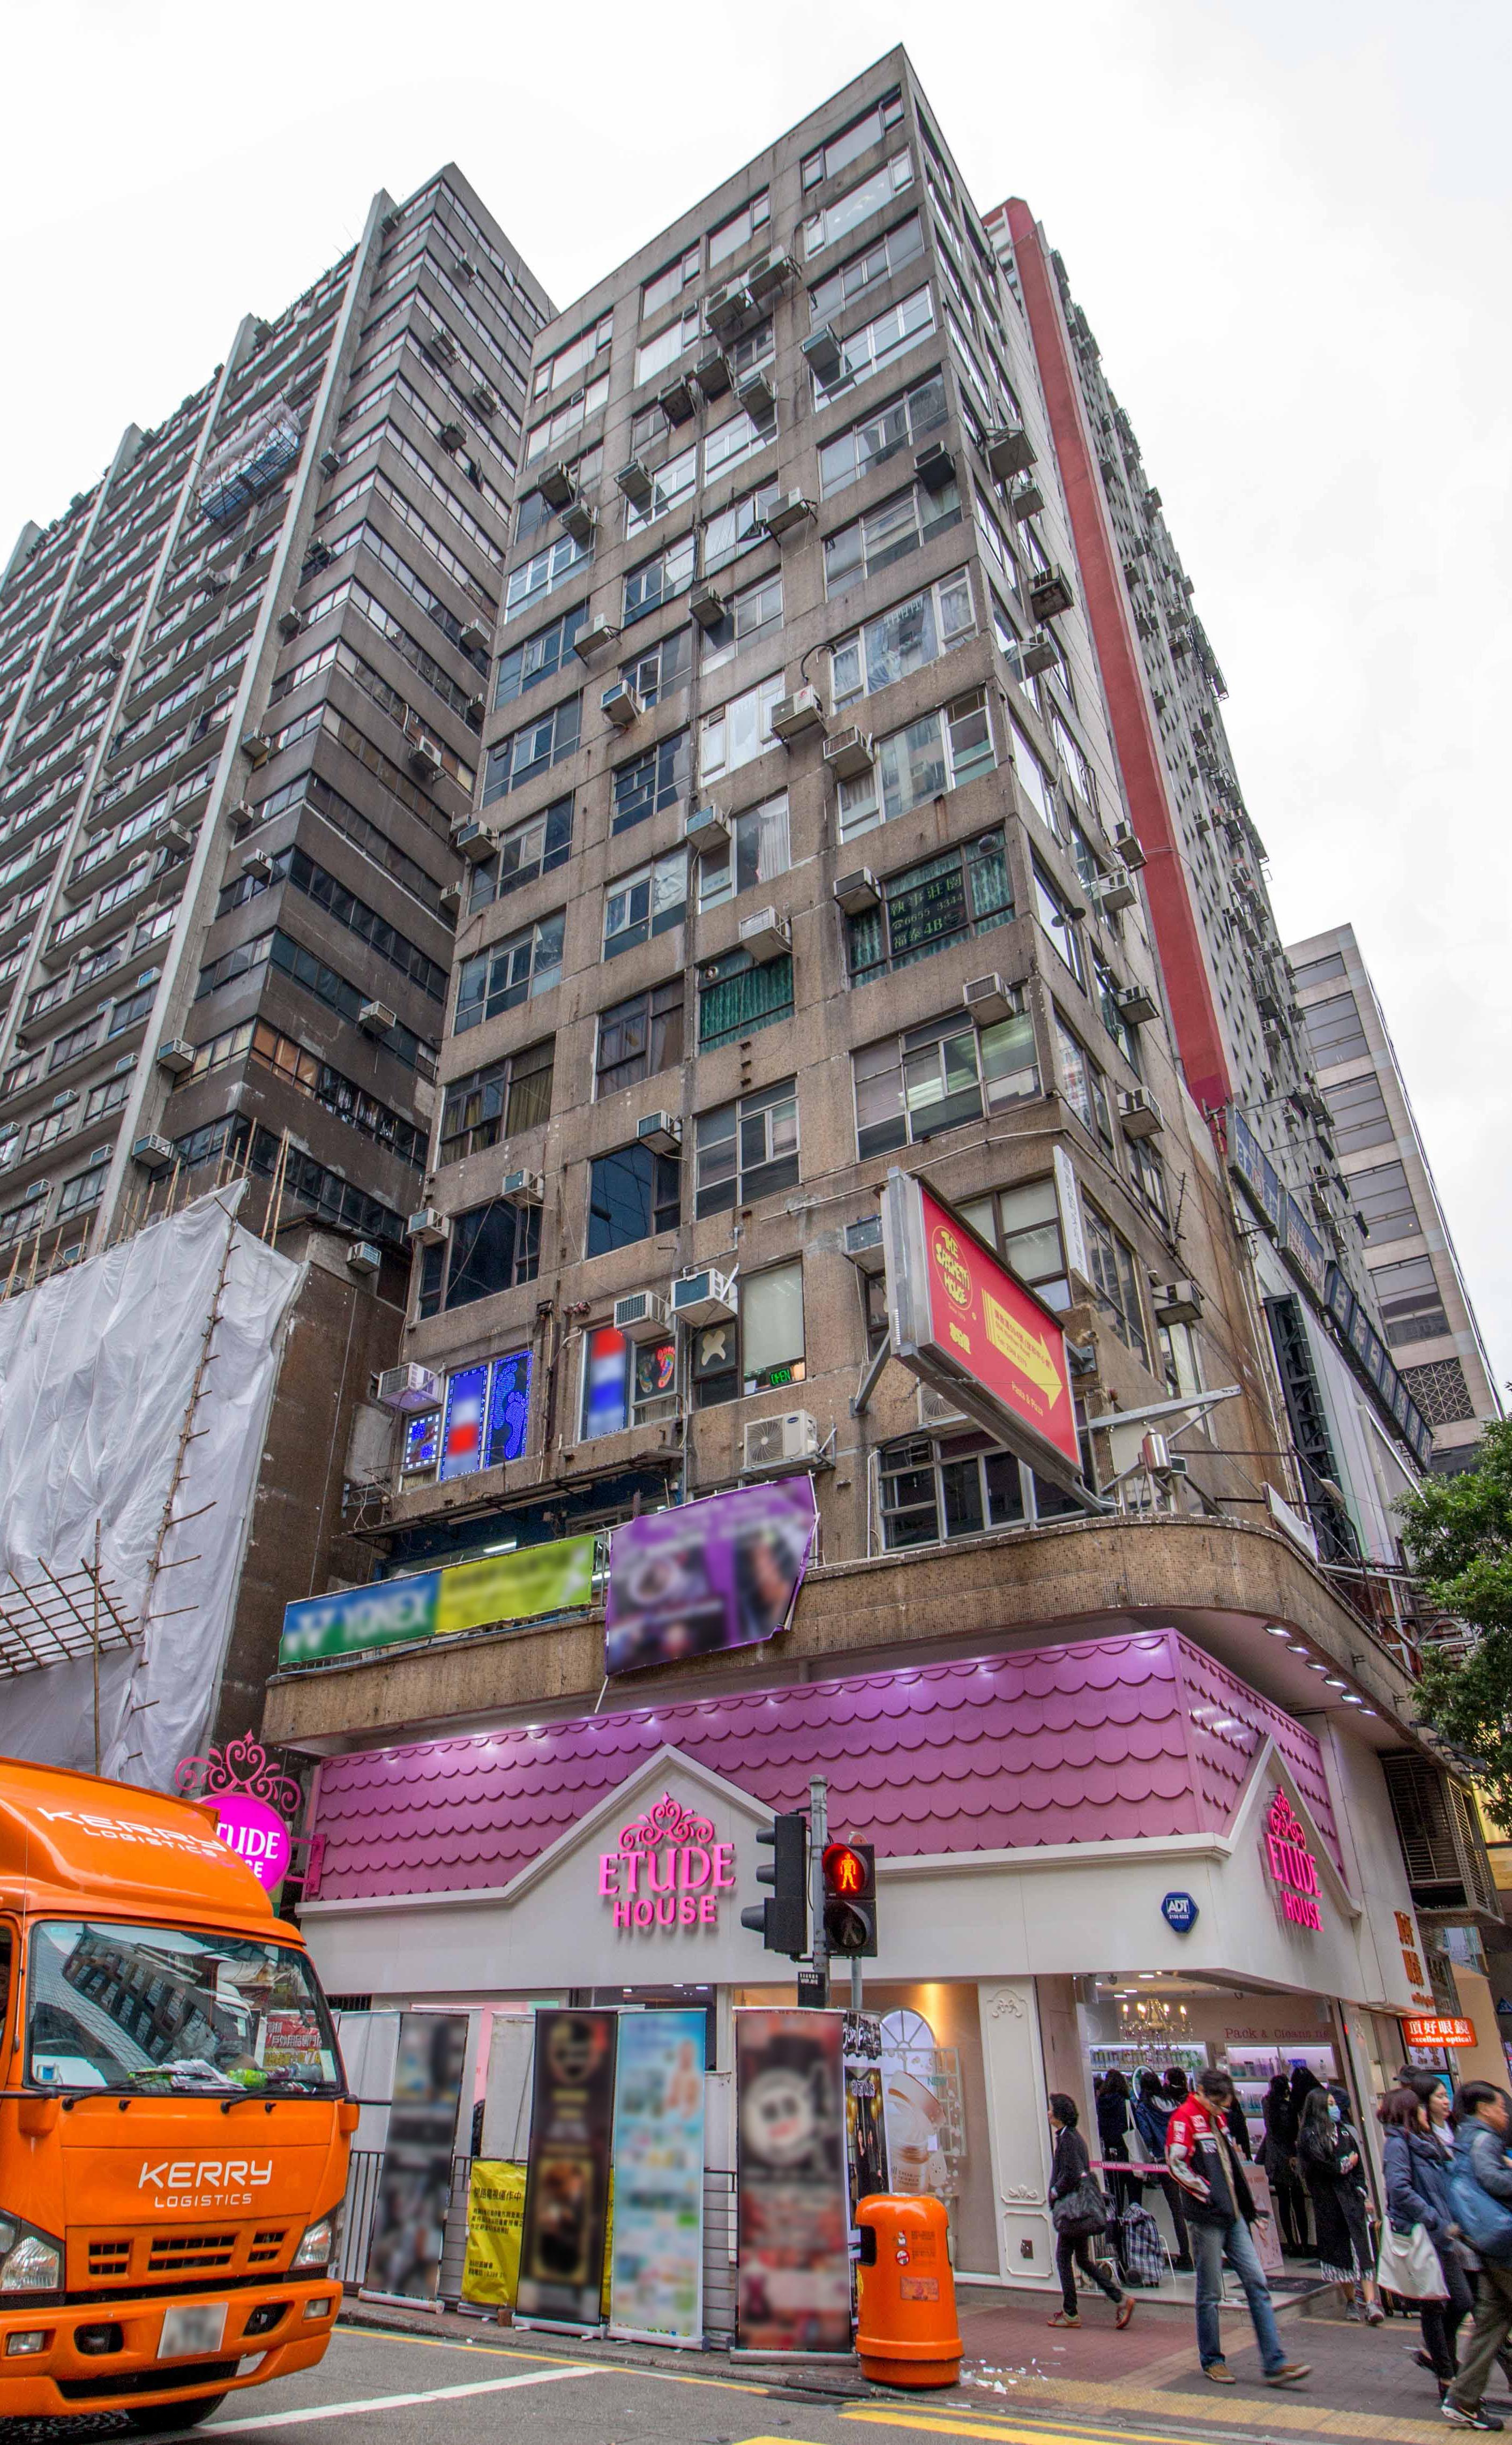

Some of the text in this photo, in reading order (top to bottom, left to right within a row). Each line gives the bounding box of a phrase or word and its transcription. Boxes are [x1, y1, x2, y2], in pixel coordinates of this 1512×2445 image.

[904, 892, 964, 925] 6655 3344
[940, 1231, 959, 1259] THE
[935, 1243, 970, 1291] SPAGHETTI
[943, 1272, 967, 1305] HOUSE
[772, 1368, 791, 1385] OPEN
[36, 1806, 228, 1852] KERRY
[83, 1827, 218, 1858] LOGISTICS
[215, 1822, 281, 1859] TUDE
[597, 1842, 736, 1896] ETUDE
[1263, 1833, 1323, 1899] ETUDE
[612, 1895, 717, 1928] HOUSE
[1167, 1900, 1189, 1913] ADT
[1279, 1890, 1324, 1933] HOUSE
[1224, 2027, 1257, 2039] Pack
[1408, 2019, 1470, 2035] 頂好眼鏡
[1445, 2036, 1472, 2044] optical
[138, 2160, 273, 2189] KERRY
[154, 2193, 252, 2208] LOGISTICS
